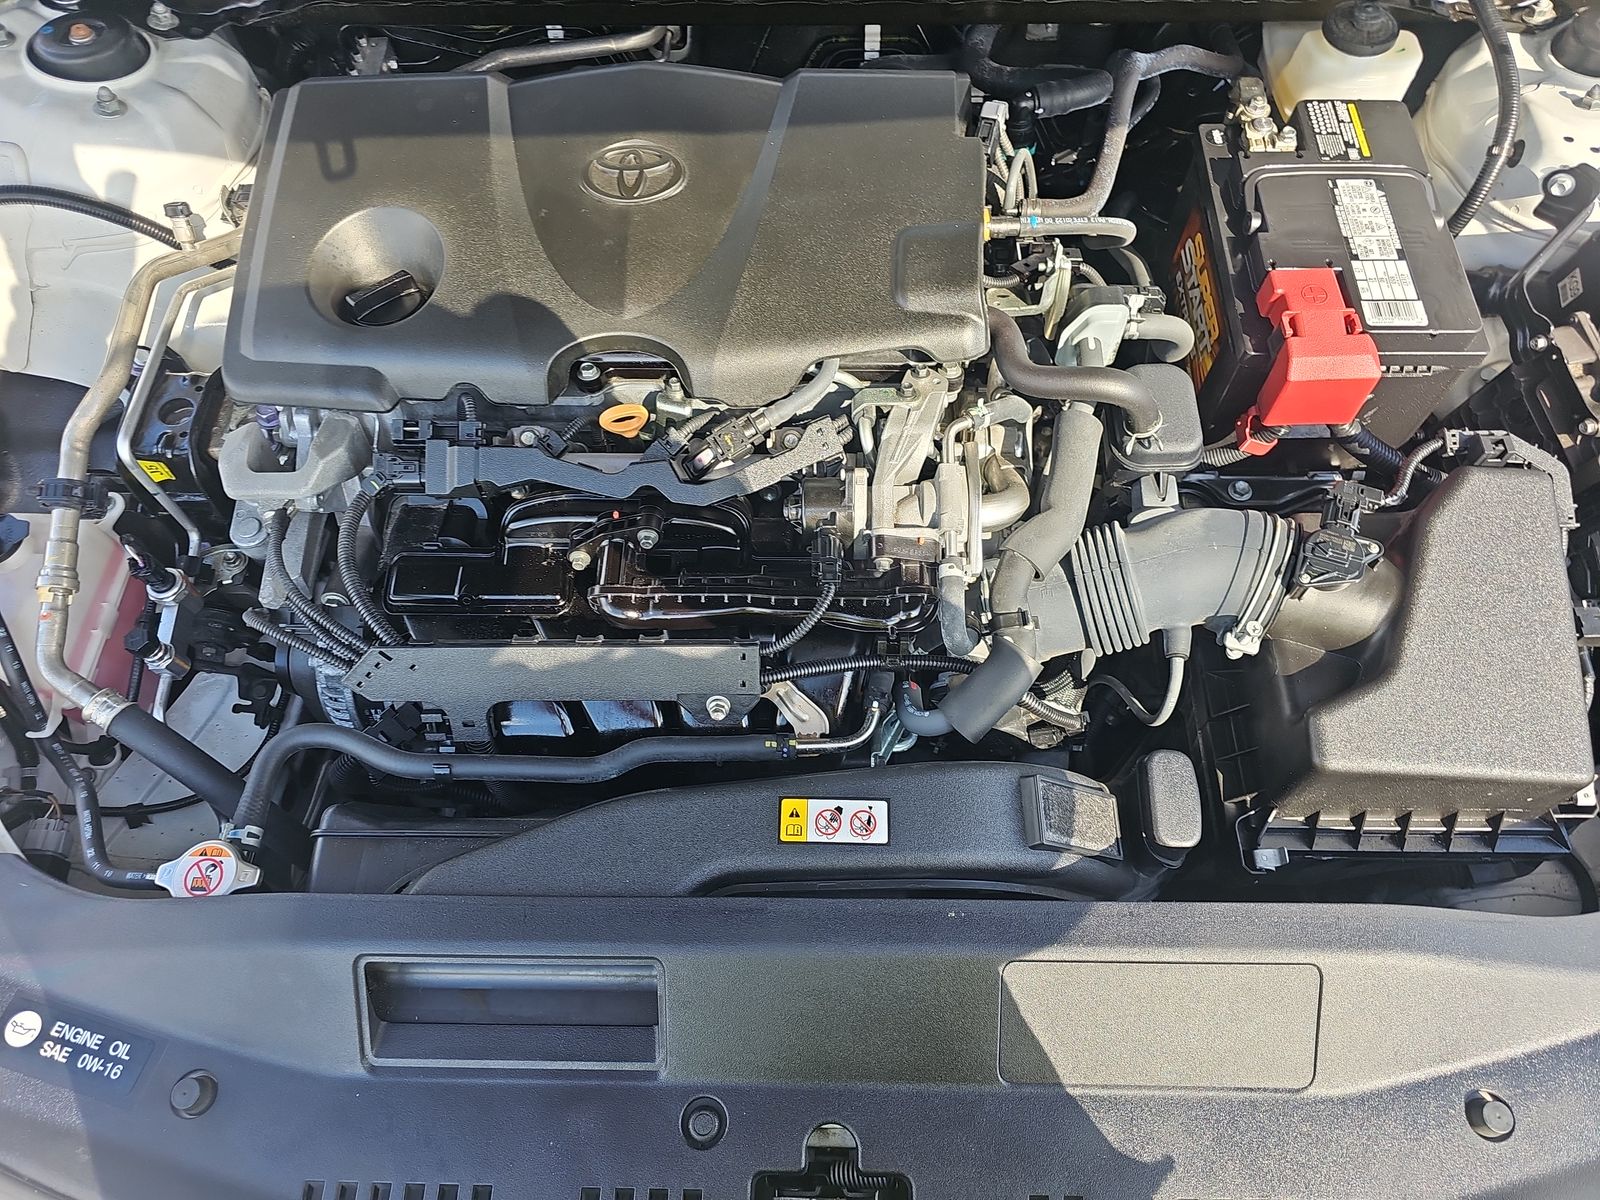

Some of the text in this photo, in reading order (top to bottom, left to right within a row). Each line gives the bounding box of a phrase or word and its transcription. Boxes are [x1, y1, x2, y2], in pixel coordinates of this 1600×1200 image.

[1180, 237, 1212, 353] START
[1194, 232, 1220, 346] SUPER
[39, 1040, 124, 1080] SAE 0W-16
[49, 1021, 131, 1060] ENGINE OIL
